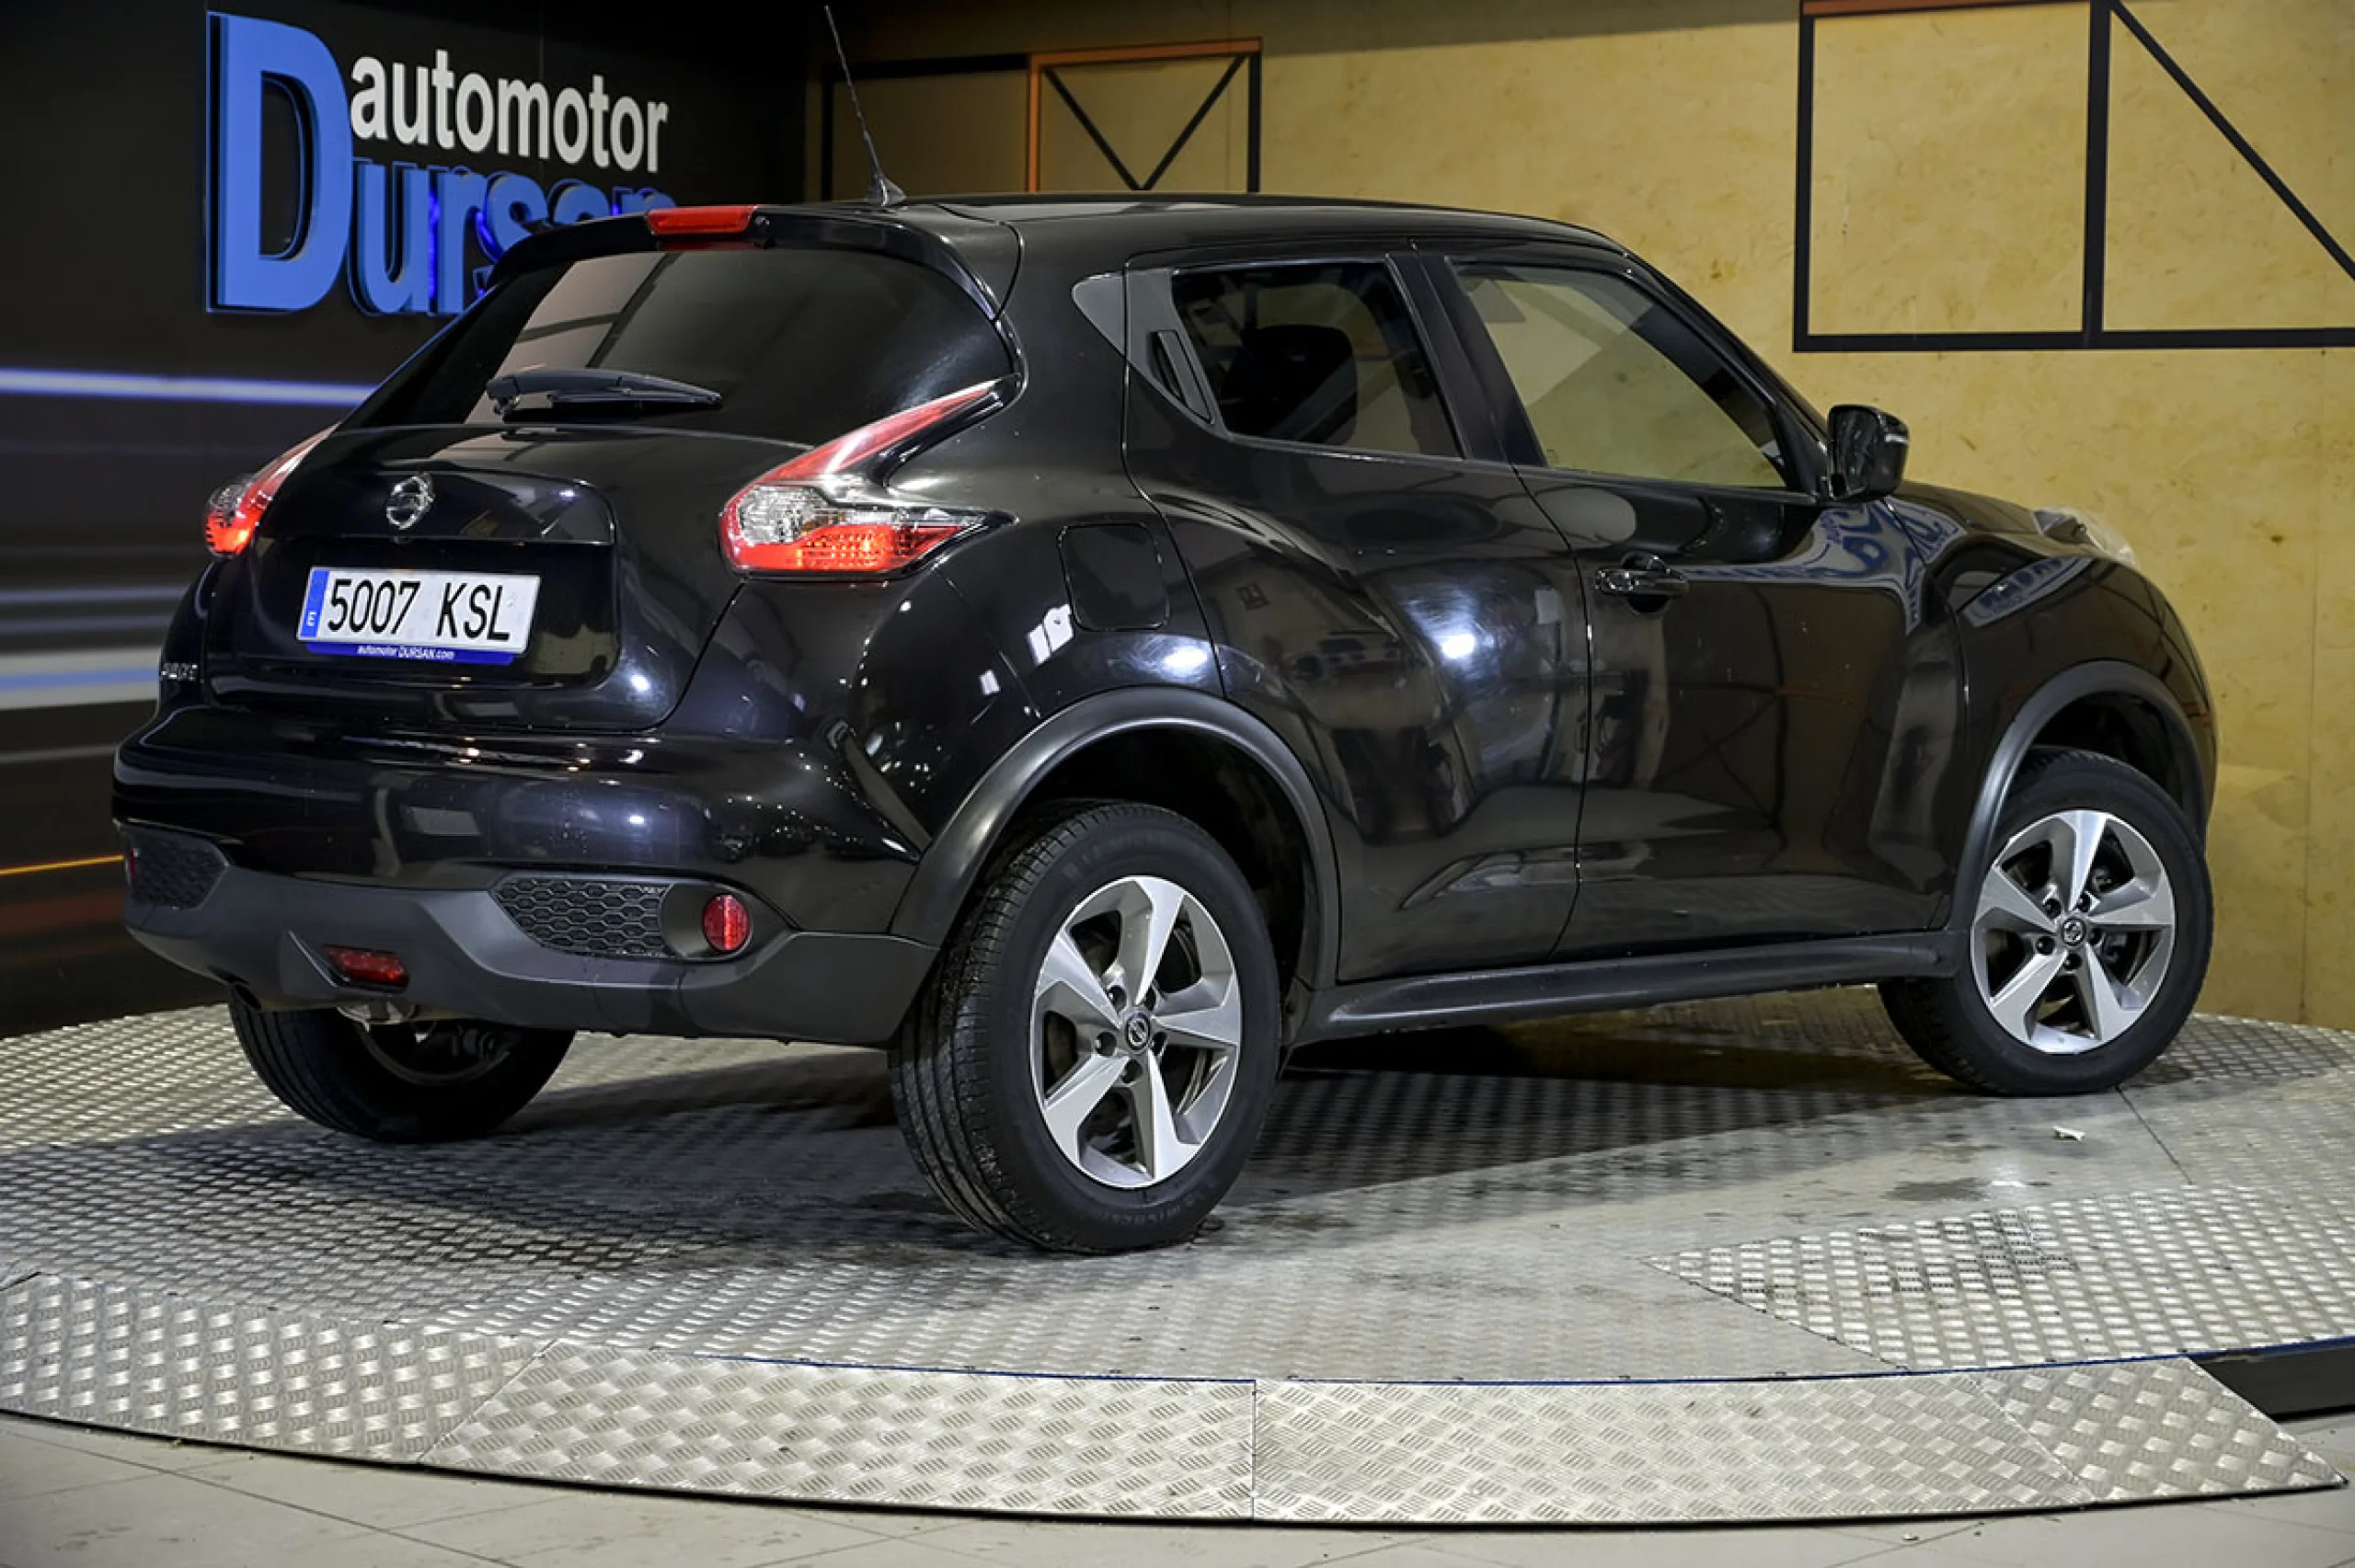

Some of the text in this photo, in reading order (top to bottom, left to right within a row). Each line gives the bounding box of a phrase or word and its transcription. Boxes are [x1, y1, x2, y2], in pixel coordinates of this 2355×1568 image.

[350, 49, 670, 174] automotor
[206, 9, 676, 316] Durs
[306, 612, 317, 626] E
[327, 578, 511, 641] 5007 KSL
